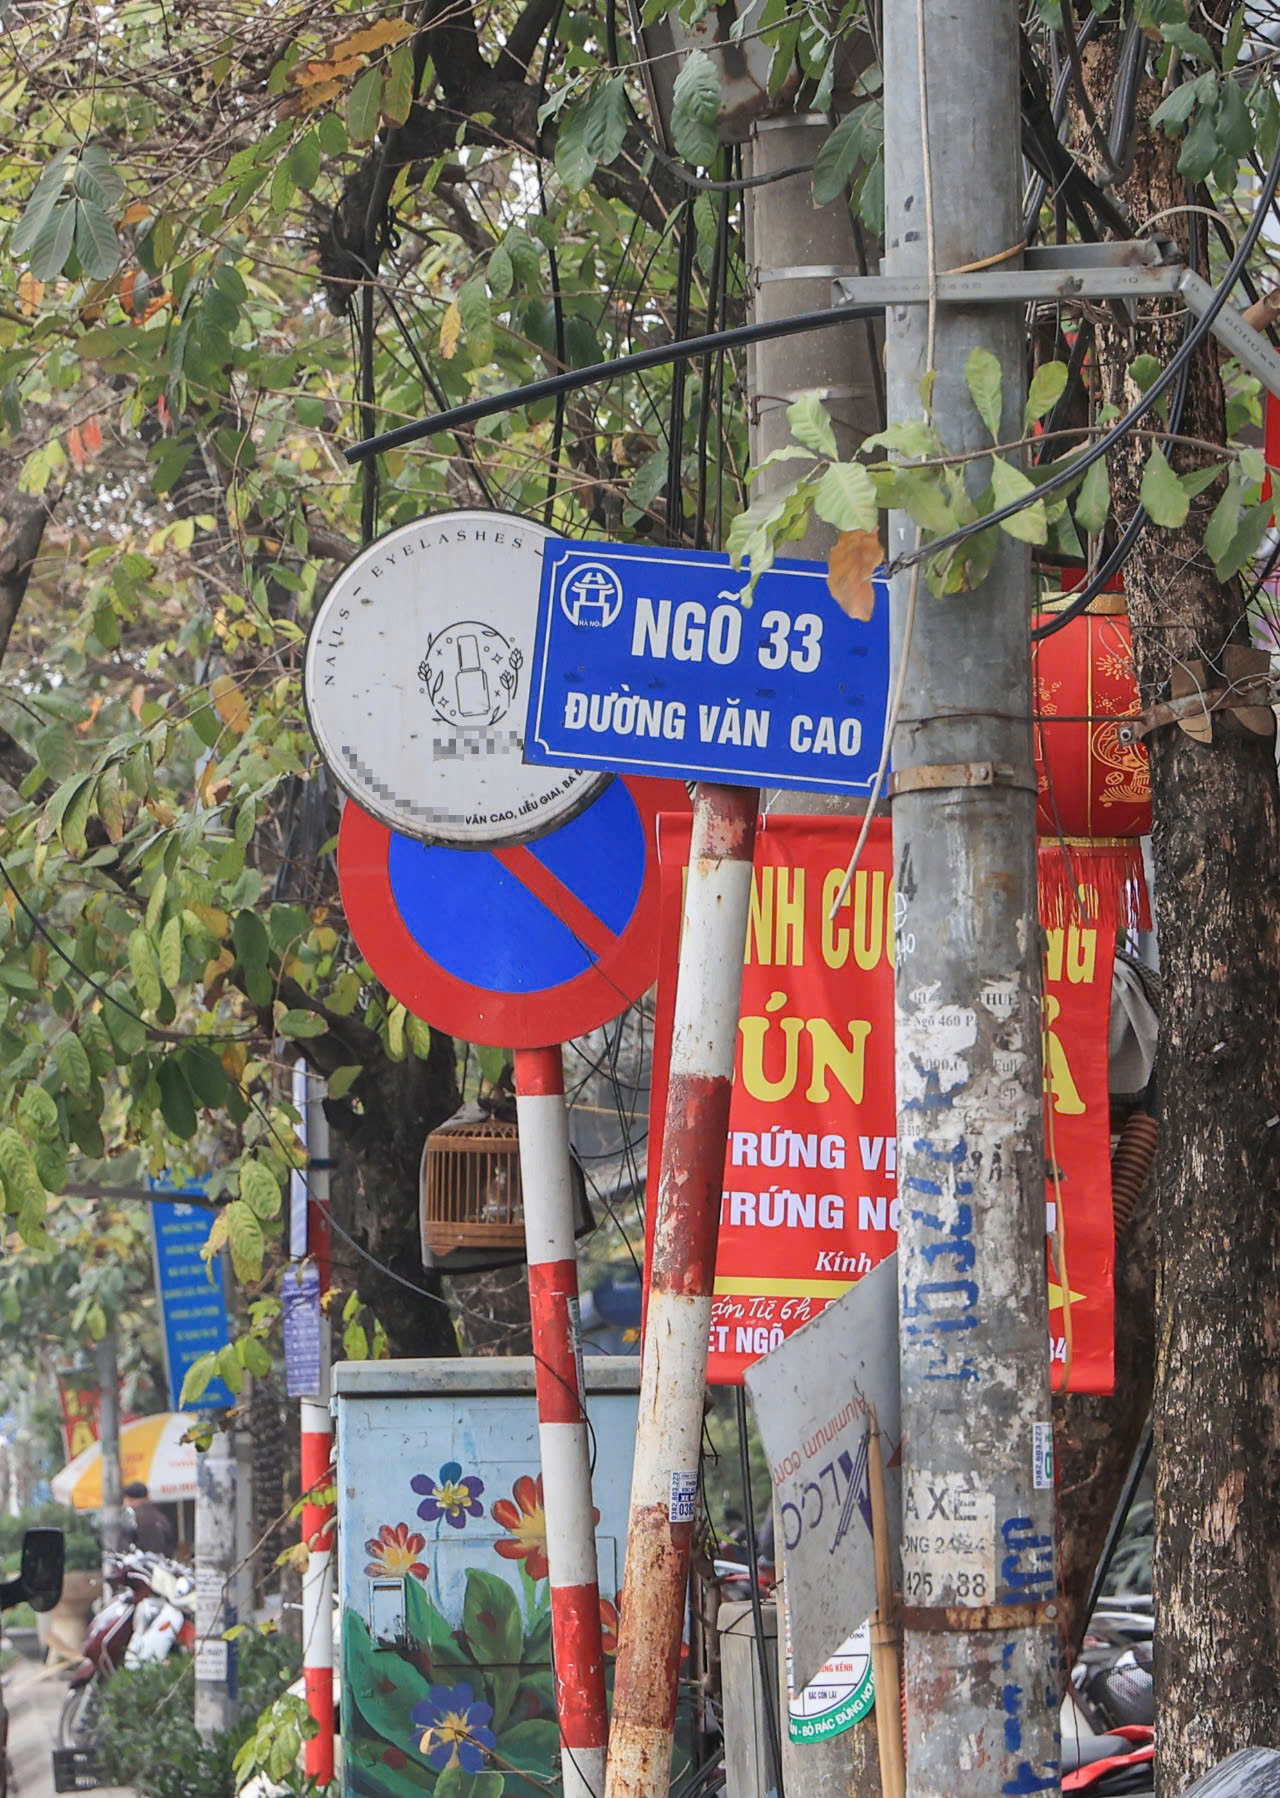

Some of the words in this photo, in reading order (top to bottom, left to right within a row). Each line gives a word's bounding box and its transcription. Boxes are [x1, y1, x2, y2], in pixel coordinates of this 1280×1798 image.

[323, 608, 351, 686] NAILS
[371, 530, 523, 579] EYELASHES
[631, 590, 743, 665] NGÕ
[758, 610, 824, 673] 33
[564, 684, 686, 740] ĐƯỜNG
[699, 697, 770, 748] VĂN
[789, 714, 863, 756] CAO
[539, 787, 565, 805] GIAI,
[738, 991, 872, 1105] ÚN
[727, 1126, 845, 1169] RỨNG
[815, 1251, 872, 1272] Kính
[711, 1296, 745, 1318] án
[780, 1297, 811, 1320] 6h
[735, 1323, 784, 1354] NGÕ
[815, 1717, 836, 1734] RÁC
[835, 1700, 865, 1725] ĐÚNG
